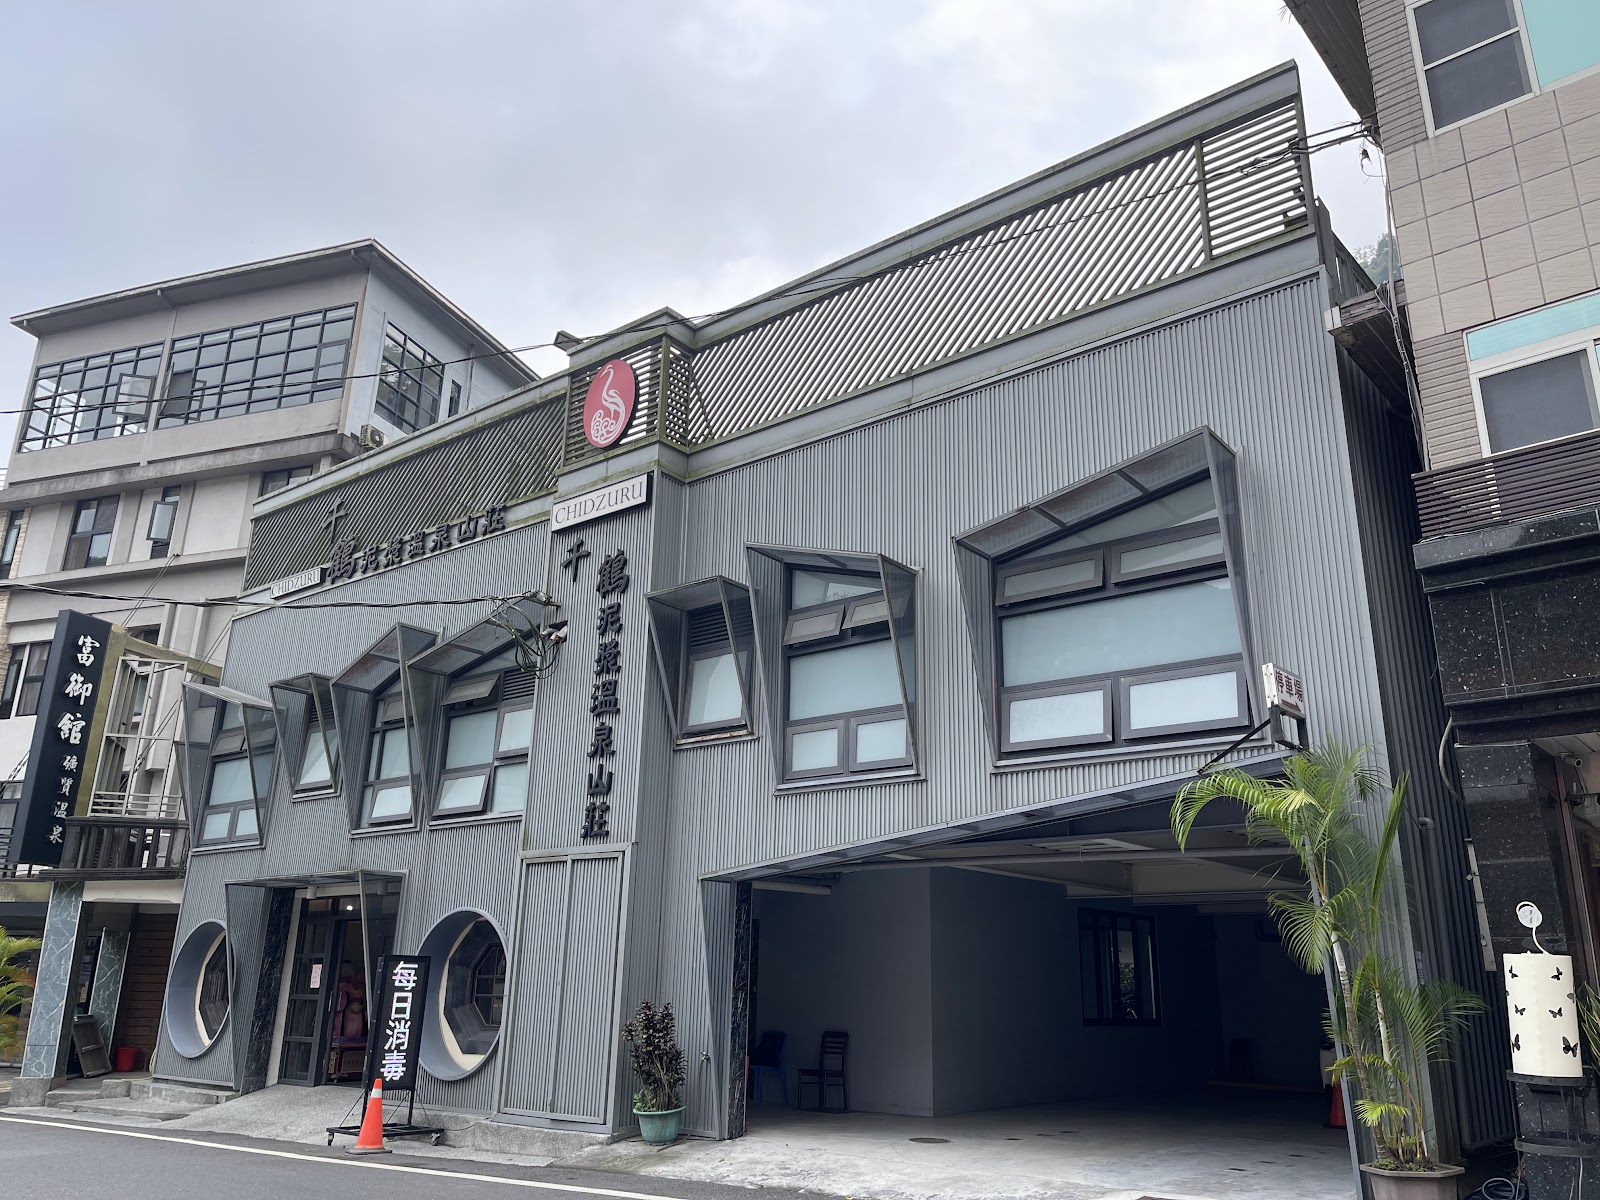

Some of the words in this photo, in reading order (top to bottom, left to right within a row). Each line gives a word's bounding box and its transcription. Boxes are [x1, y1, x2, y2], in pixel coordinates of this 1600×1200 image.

[554, 481, 644, 525] CHIDZURU
[271, 569, 320, 597] CHIDZURU
[380, 960, 418, 1082] 每日消毒
